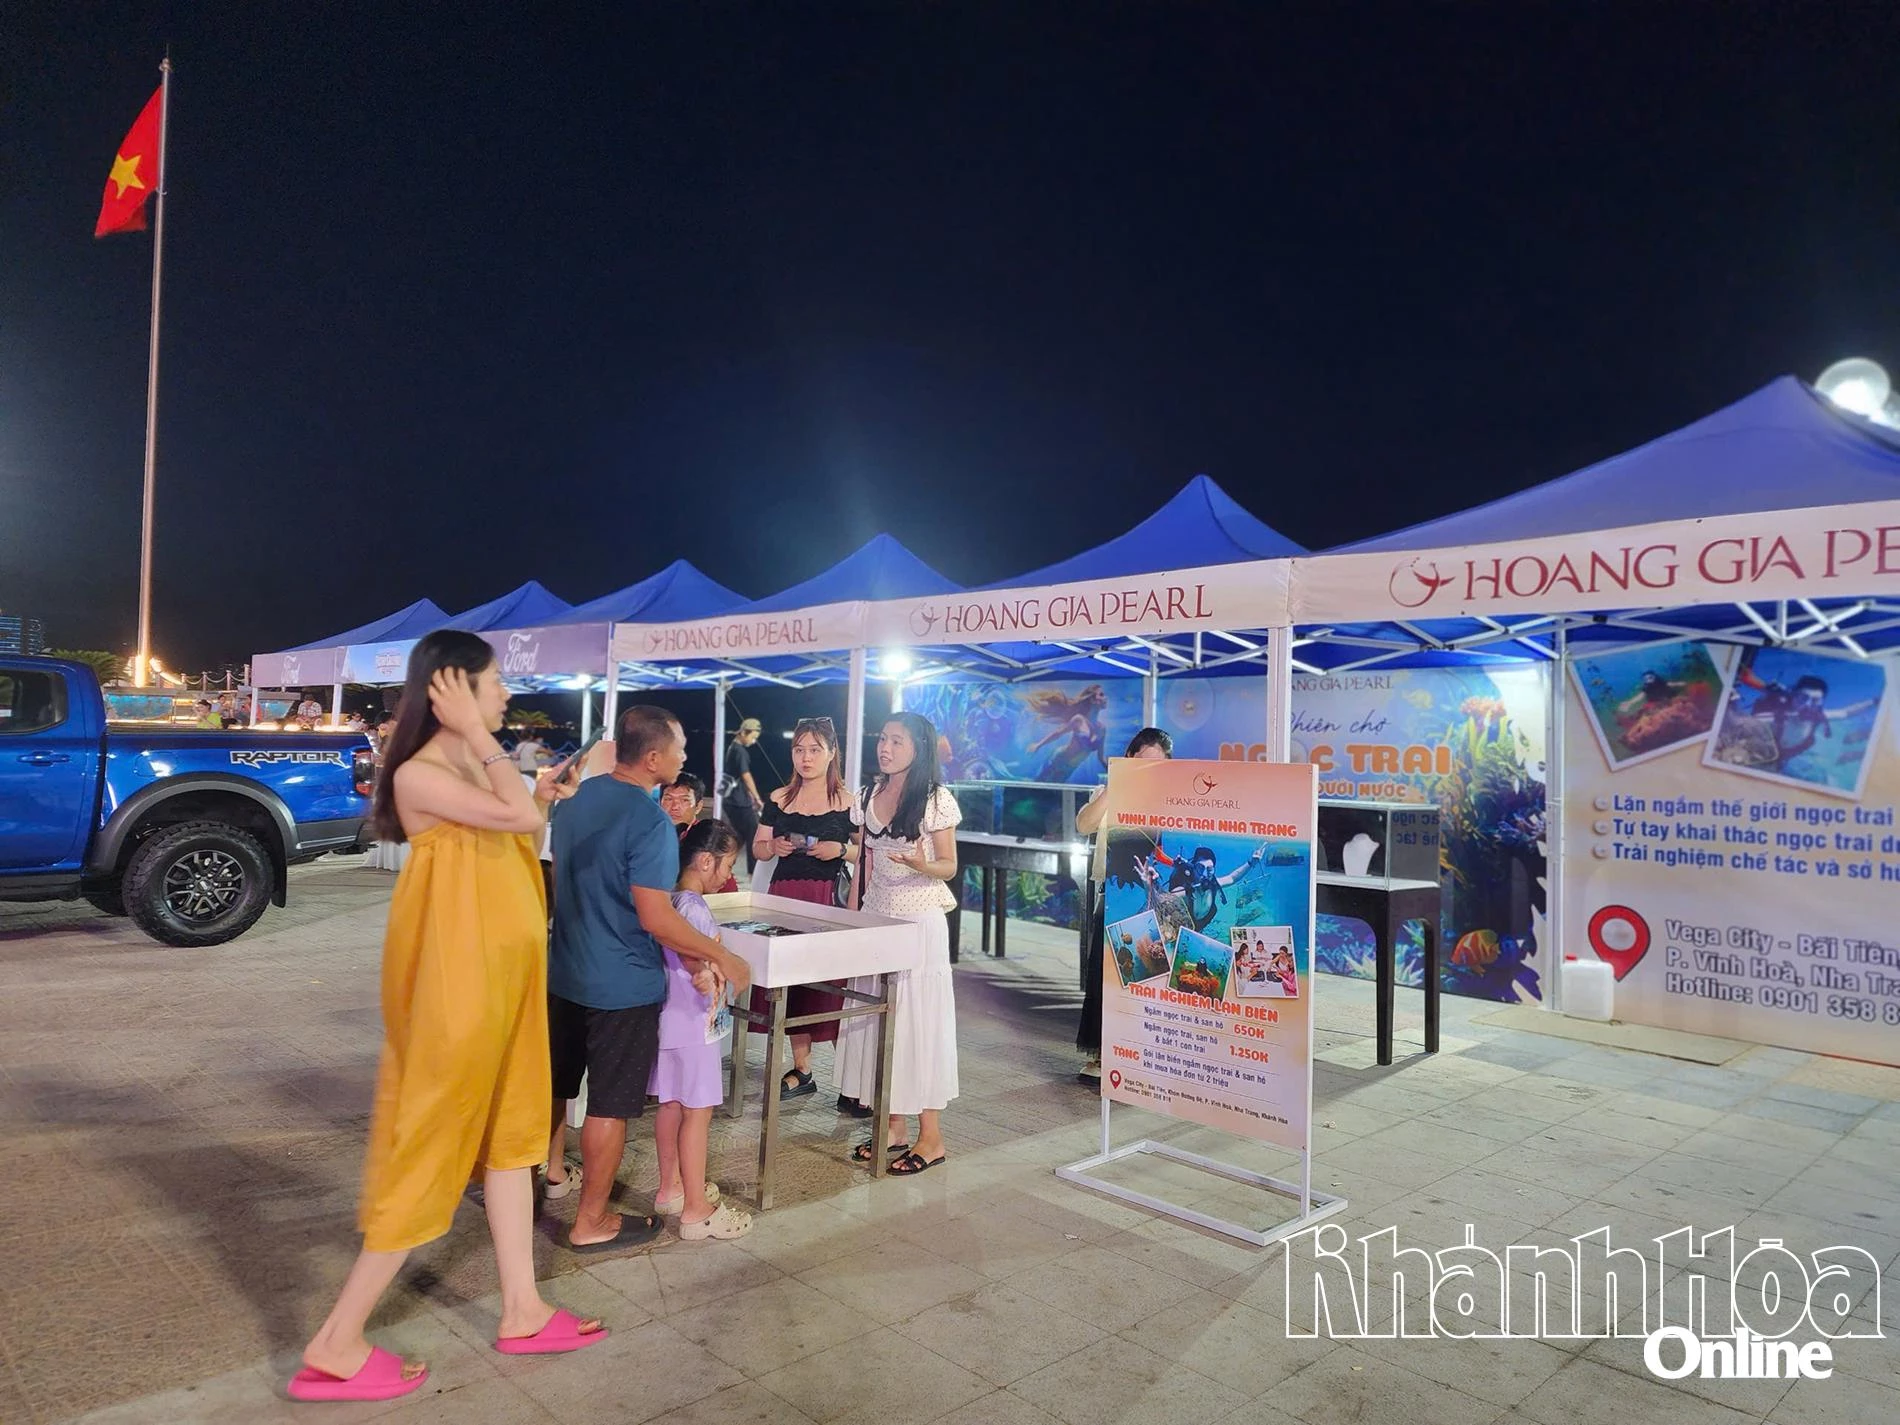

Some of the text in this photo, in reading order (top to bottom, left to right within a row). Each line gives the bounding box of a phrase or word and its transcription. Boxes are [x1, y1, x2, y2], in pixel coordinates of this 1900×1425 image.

[1463, 545, 1678, 601] HOANG
[1697, 535, 1806, 584] GIA
[945, 584, 1213, 632] HOANG GIA PEARL
[664, 618, 818, 651] HOANG GIA PEARL
[504, 632, 540, 673] Ford
[1344, 675, 1395, 690] PEARL
[230, 751, 351, 769] RAPTOR
[1346, 744, 1452, 775] TRAI
[1166, 798, 1196, 807] HOANG
[1211, 800, 1241, 810] PEARL
[1652, 795, 1704, 817] ngắm
[1711, 798, 1744, 817] thế
[1750, 802, 1787, 822] giới
[1795, 807, 1846, 827] ngọc
[1855, 806, 1893, 826] trai
[1149, 815, 1183, 831] NGỌC
[1185, 817, 1215, 832] TRAI
[1218, 819, 1247, 833] NHA
[1249, 821, 1297, 837] TRANG
[1613, 819, 1636, 839] Tự
[1641, 821, 1669, 841] tay
[1676, 822, 1717, 841] khai
[1723, 826, 1768, 845] thác
[1776, 832, 1827, 852] ngọc
[1835, 832, 1873, 852] trai
[1613, 842, 1648, 861] Trải
[1655, 847, 1724, 869] nghiệm
[1731, 852, 1769, 871] chế
[1774, 855, 1808, 874] tác
[1815, 858, 1840, 876] và
[1665, 919, 1722, 948] Vega
[1727, 926, 1773, 955] City
[1797, 933, 1838, 960] Bãi
[1666, 946, 1689, 969] P.
[1810, 964, 1860, 993] Nha
[1666, 972, 1753, 1004] Hotline:
[1759, 985, 1819, 1015] 0901
[1827, 994, 1877, 1023] 358
[1180, 1013, 1193, 1022] trai
[1201, 1018, 1213, 1027] san
[1234, 1024, 1265, 1039] 650K
[1180, 1041, 1193, 1051] con
[1194, 1044, 1206, 1053] trai
[1196, 1034, 1208, 1042] san
[1229, 1045, 1269, 1063] 1.250K
[1206, 1074, 1211, 1084] 2
[1220, 1067, 1233, 1077] trai
[1242, 1072, 1255, 1082] san
